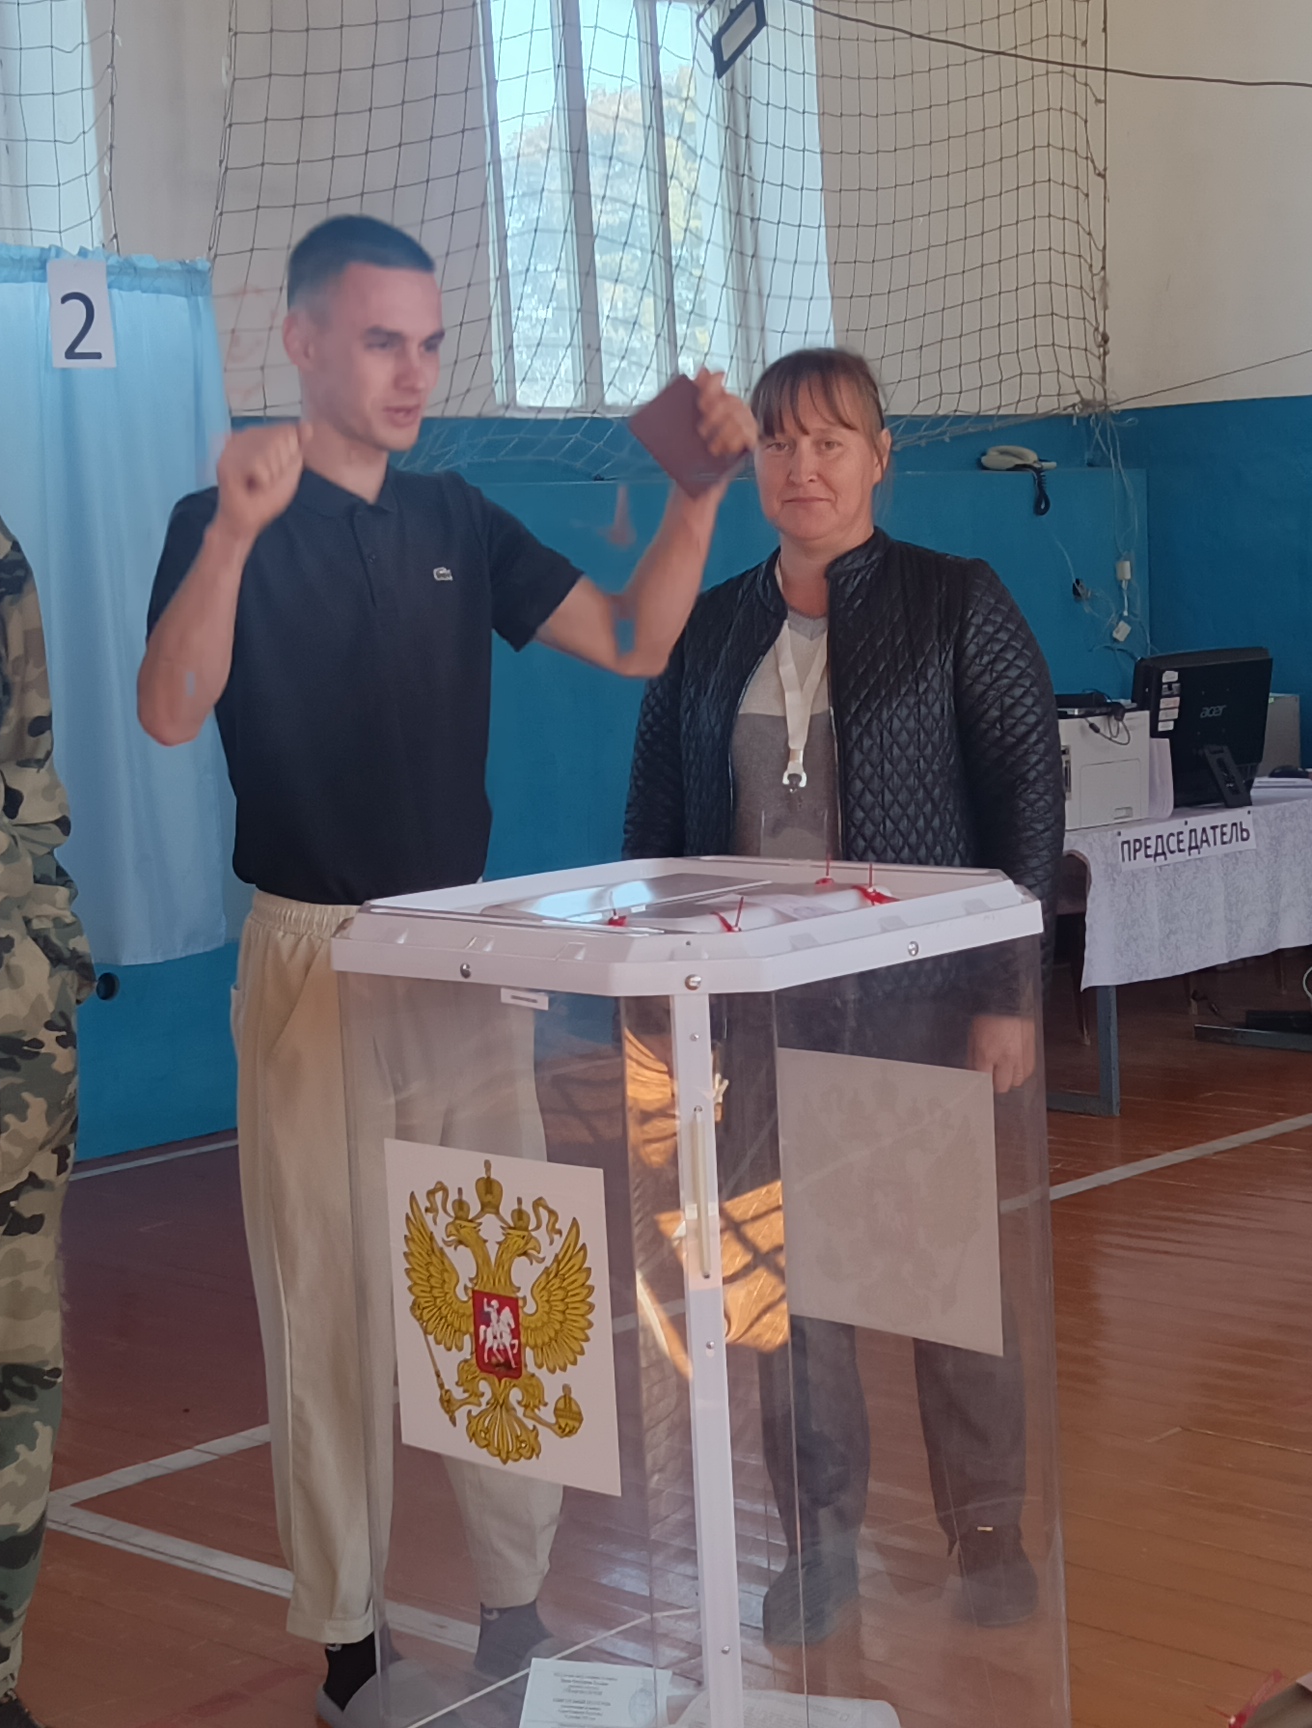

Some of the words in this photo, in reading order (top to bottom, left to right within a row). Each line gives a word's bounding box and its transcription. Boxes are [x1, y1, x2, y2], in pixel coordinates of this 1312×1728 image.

[60, 291, 103, 360] 2
[1200, 704, 1227, 718] acer
[1120, 821, 1251, 862] ПРЕДСЕДАТЕЛЬ
